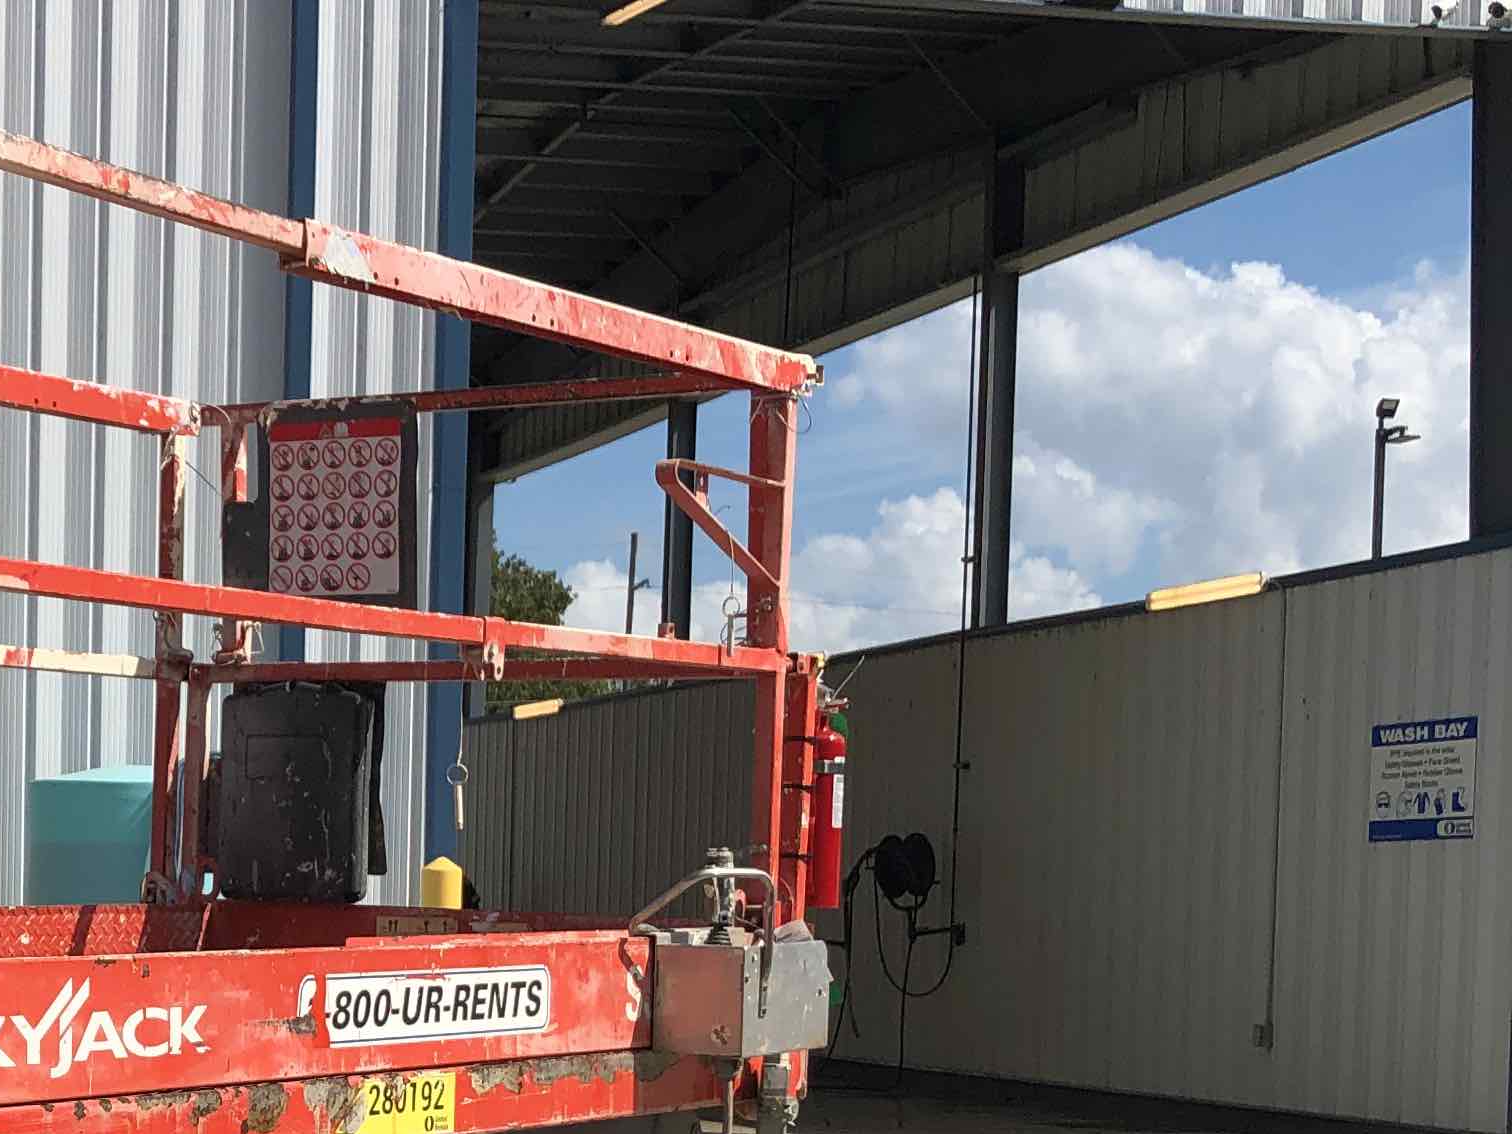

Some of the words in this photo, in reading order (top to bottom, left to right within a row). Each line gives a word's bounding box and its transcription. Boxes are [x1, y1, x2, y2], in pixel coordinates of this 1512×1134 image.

[1380, 725, 1429, 744] WASH
[1434, 721, 1468, 739] BAY
[308, 979, 543, 1030] -800-UR-RENTS
